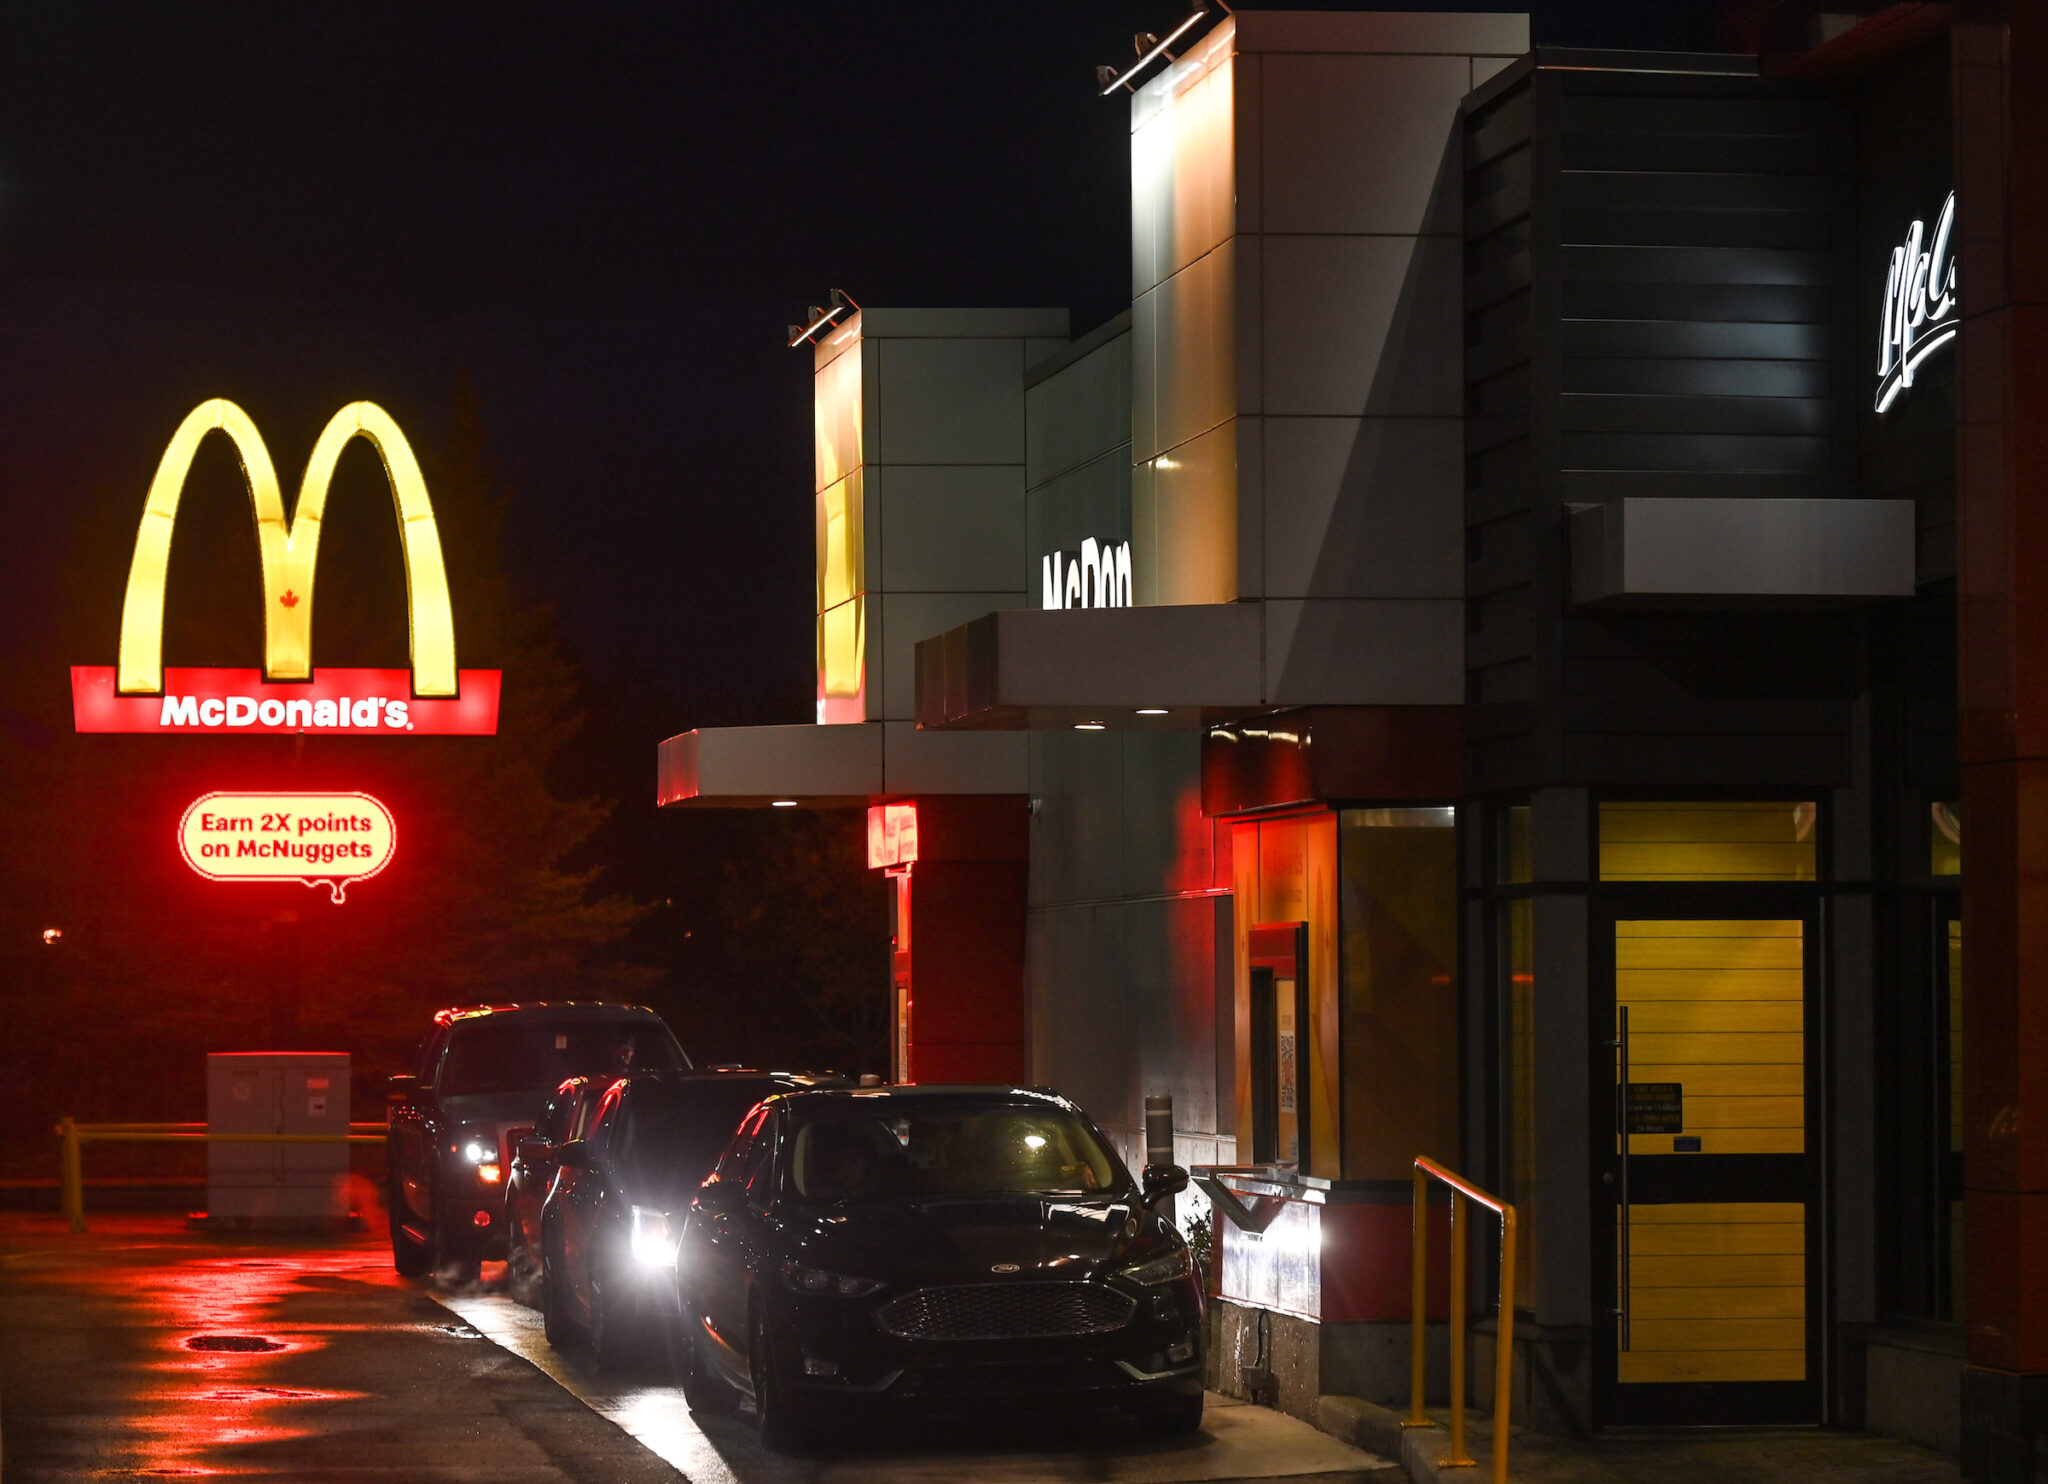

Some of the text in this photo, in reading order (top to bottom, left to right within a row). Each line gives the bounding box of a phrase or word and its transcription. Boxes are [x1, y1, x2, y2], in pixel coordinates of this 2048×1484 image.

[201, 812, 372, 837] Earn 2X points
[200, 840, 373, 863] on McNuggets
